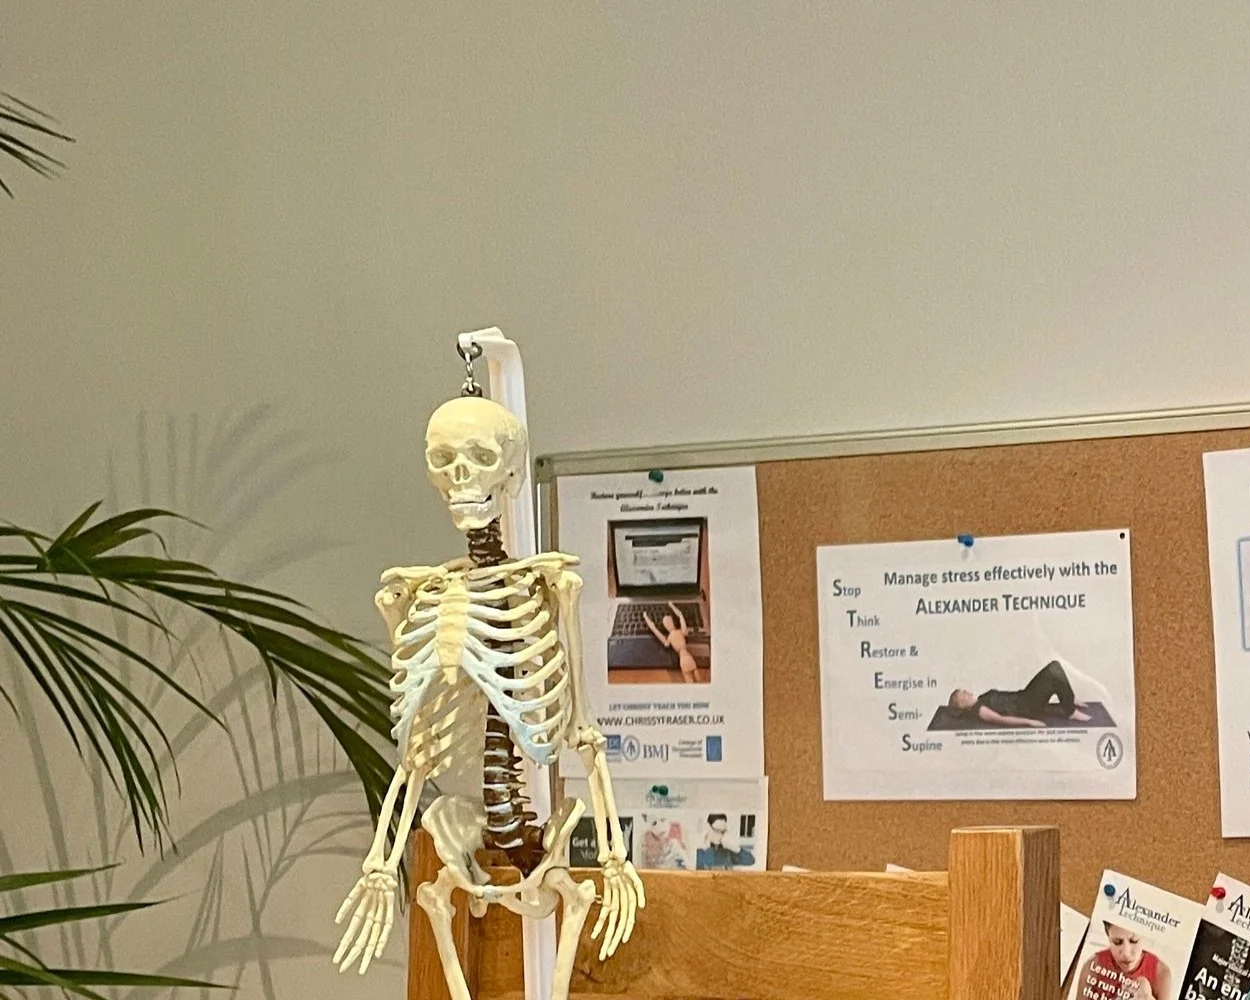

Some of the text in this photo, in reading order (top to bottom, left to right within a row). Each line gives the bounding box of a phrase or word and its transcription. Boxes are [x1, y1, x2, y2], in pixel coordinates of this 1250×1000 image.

[884, 561, 1118, 587] Manage stress effectively with the
[833, 578, 861, 598] Stop
[915, 594, 1086, 615] ALEXANDER TECHNIQUE
[846, 610, 880, 628] Think
[860, 640, 906, 658] Restore
[874, 671, 937, 691] Energise in
[888, 702, 922, 720] Semi-
[643, 744, 669, 762] BMJ
[902, 733, 942, 754] Supine
[1116, 887, 1182, 929] Alexander
[1086, 974, 1097, 986] to
[1097, 980, 1116, 994] run
[1089, 961, 1140, 989] Learn how
[1194, 967, 1219, 991] An
